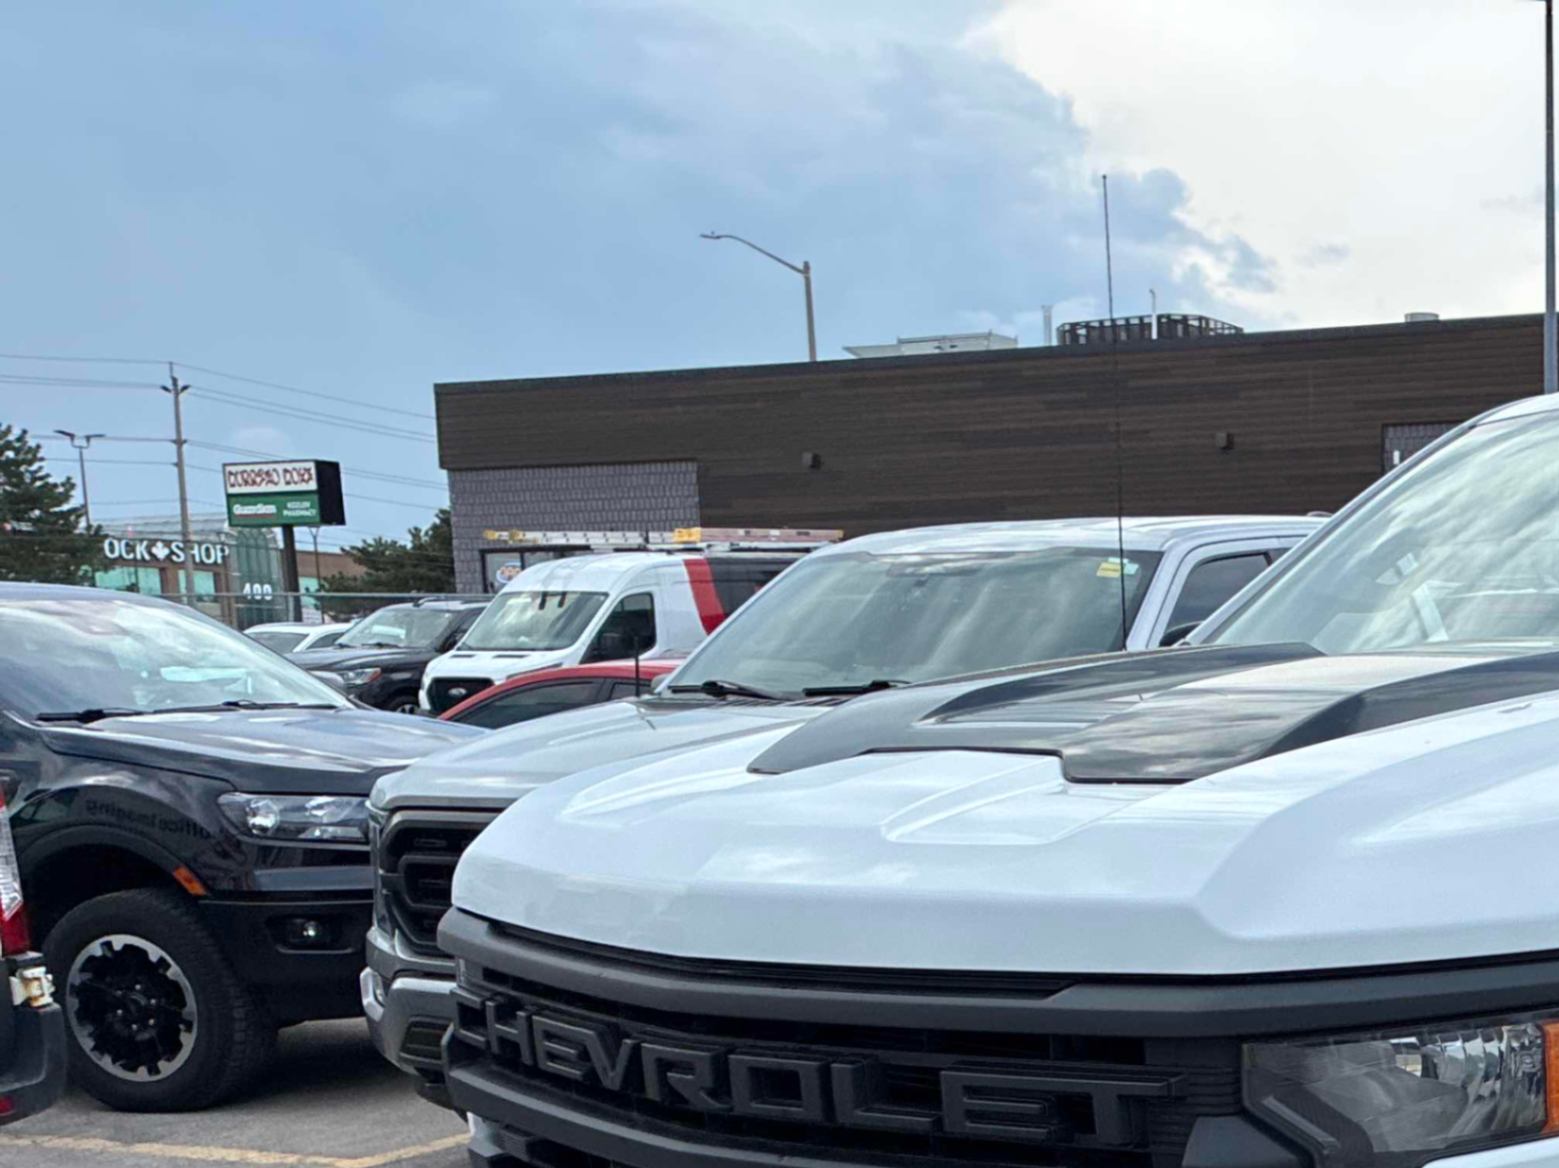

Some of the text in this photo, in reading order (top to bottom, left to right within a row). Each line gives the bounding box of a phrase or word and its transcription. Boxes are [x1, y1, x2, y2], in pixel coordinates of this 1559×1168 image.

[104, 538, 151, 561] OCK
[243, 583, 273, 601] 400
[453, 986, 1180, 1147] CHEVROLET
